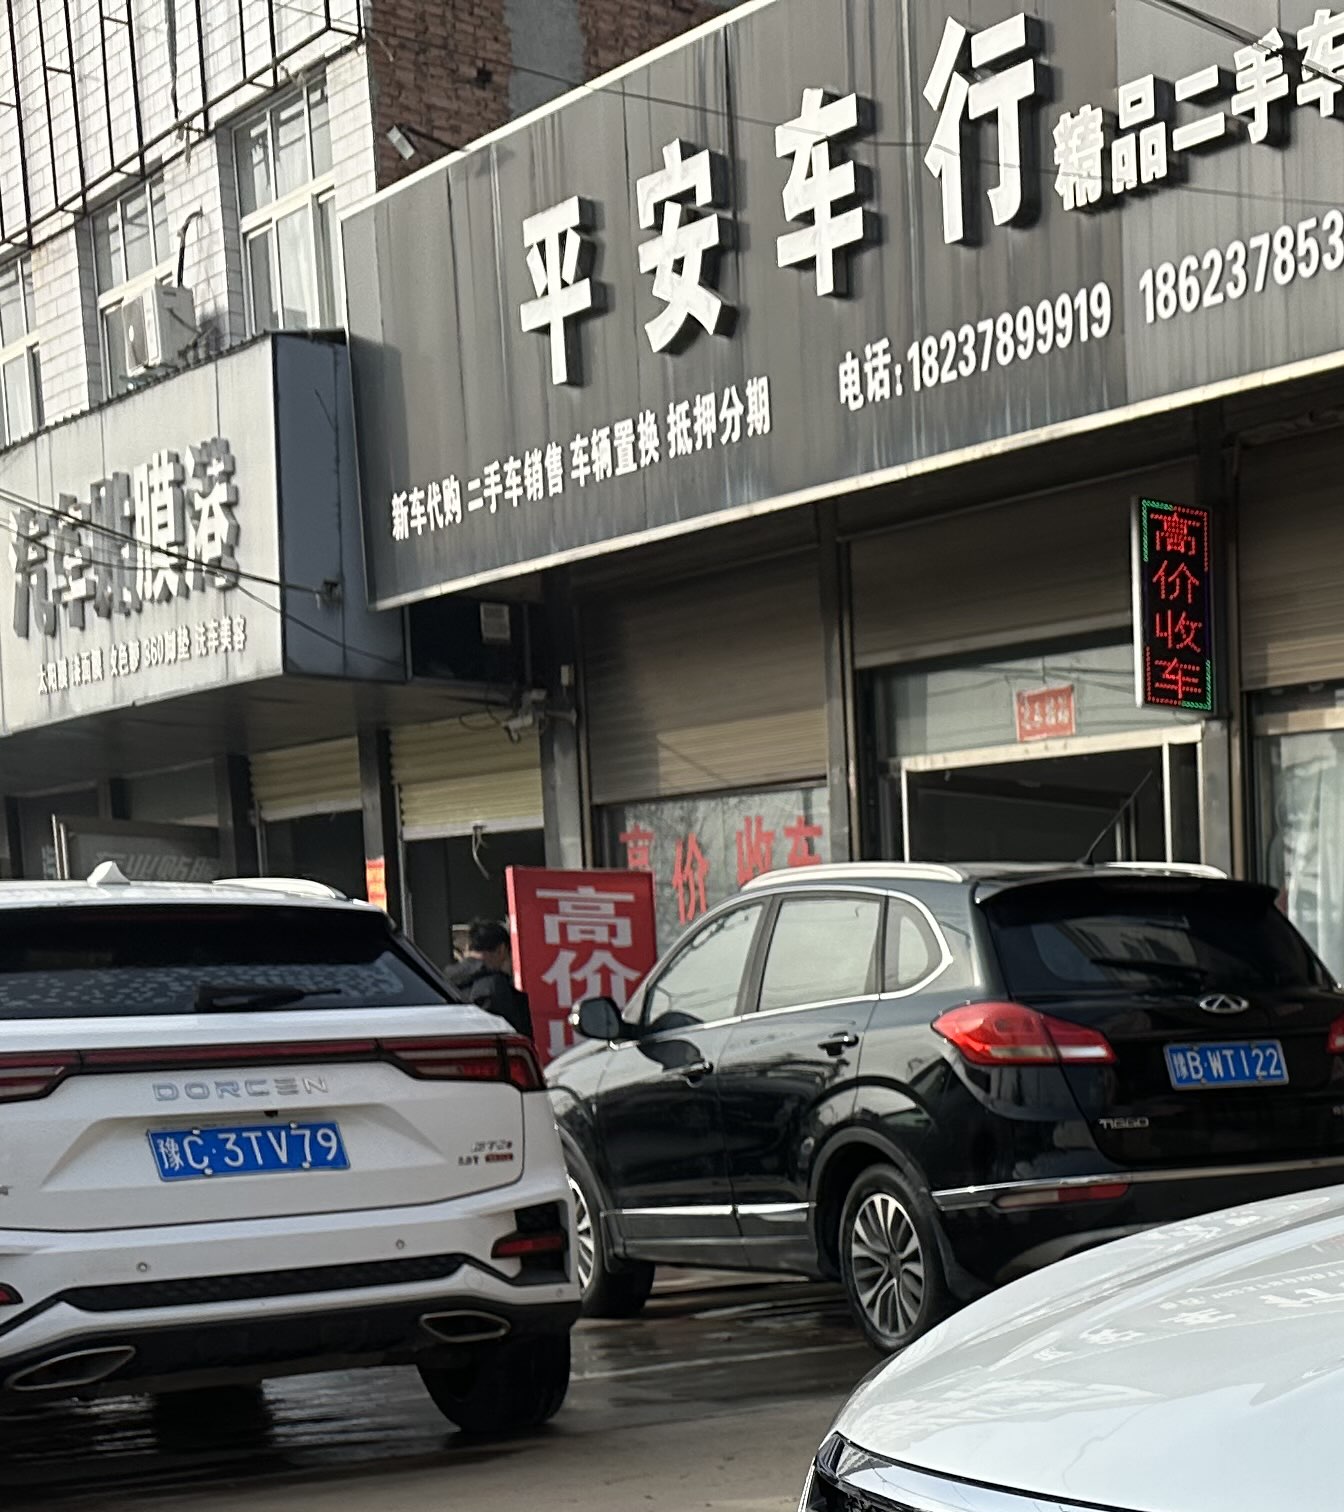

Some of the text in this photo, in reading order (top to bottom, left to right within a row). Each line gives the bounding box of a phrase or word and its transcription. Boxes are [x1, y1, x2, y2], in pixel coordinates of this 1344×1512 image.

[520, 13, 1038, 386] 平安车行
[391, 375, 771, 541] 新车代购 二手车销售 车辆置换 抵押分期
[1152, 512, 1203, 700] 高价收车
[152, 1076, 329, 1102] DORCEN
